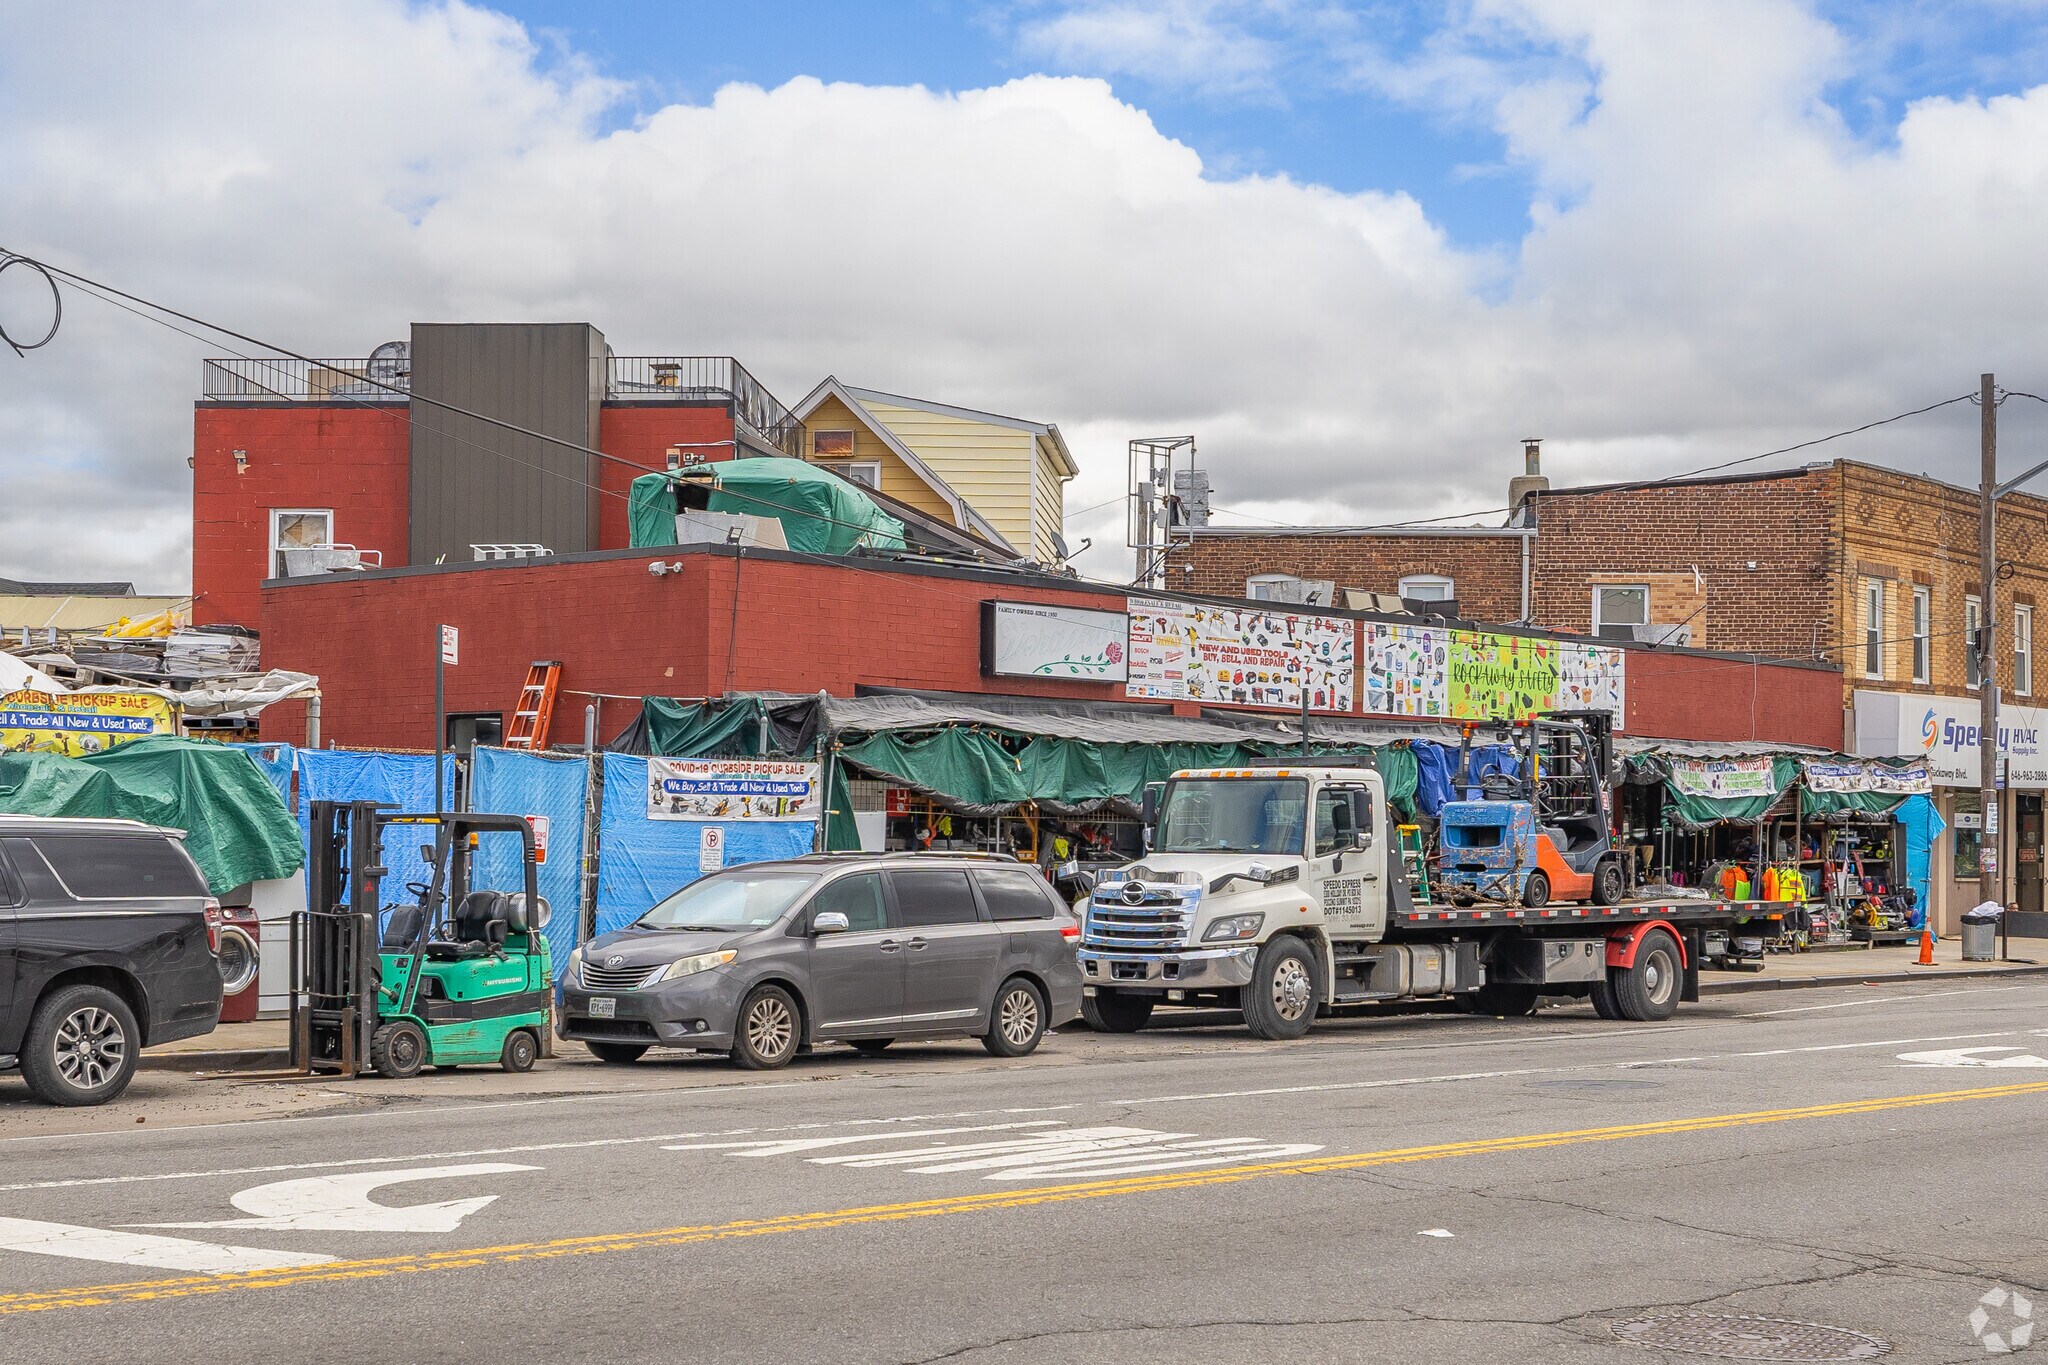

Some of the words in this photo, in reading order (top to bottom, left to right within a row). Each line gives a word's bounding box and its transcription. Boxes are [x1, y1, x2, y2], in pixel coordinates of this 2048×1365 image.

[1199, 643, 1219, 652] NEW
[1220, 646, 1240, 654] AND
[1241, 648, 1262, 656] USED
[1263, 650, 1289, 658] TOOLS
[1203, 653, 1219, 663] BUY,
[1221, 655, 1241, 665] SELL,
[1243, 656, 1258, 665] AND
[1260, 658, 1286, 668] REPAIR
[71, 694, 117, 706] PICKUP
[120, 697, 149, 709] SALE
[10, 713, 17, 725] &
[19, 714, 49, 726] Trade
[52, 715, 64, 727] All
[66, 716, 89, 728] New
[91, 717, 100, 728] &
[102, 718, 125, 729] Used
[127, 719, 148, 730] Tools
[2013, 728, 2038, 744] HVAC
[2012, 746, 2029, 756] Supply
[669, 762, 709, 773] COVID-19
[711, 763, 751, 774] CURBSIDE
[754, 763, 783, 774] PICKUP
[785, 763, 805, 775] SALE
[1955, 768, 1968, 779] Blvd.
[667, 780, 680, 791] We
[712, 782, 718, 792] &
[719, 782, 738, 792] Trade
[739, 782, 748, 792] All
[749, 783, 764, 792] New
[766, 783, 772, 792] &
[773, 783, 788, 793] Used
[789, 783, 805, 793] Tools
[1323, 880, 1341, 889] SPEEDO
[1342, 879, 1361, 888] EXPRESS
[487, 977, 522, 986] MITSUBISHI
